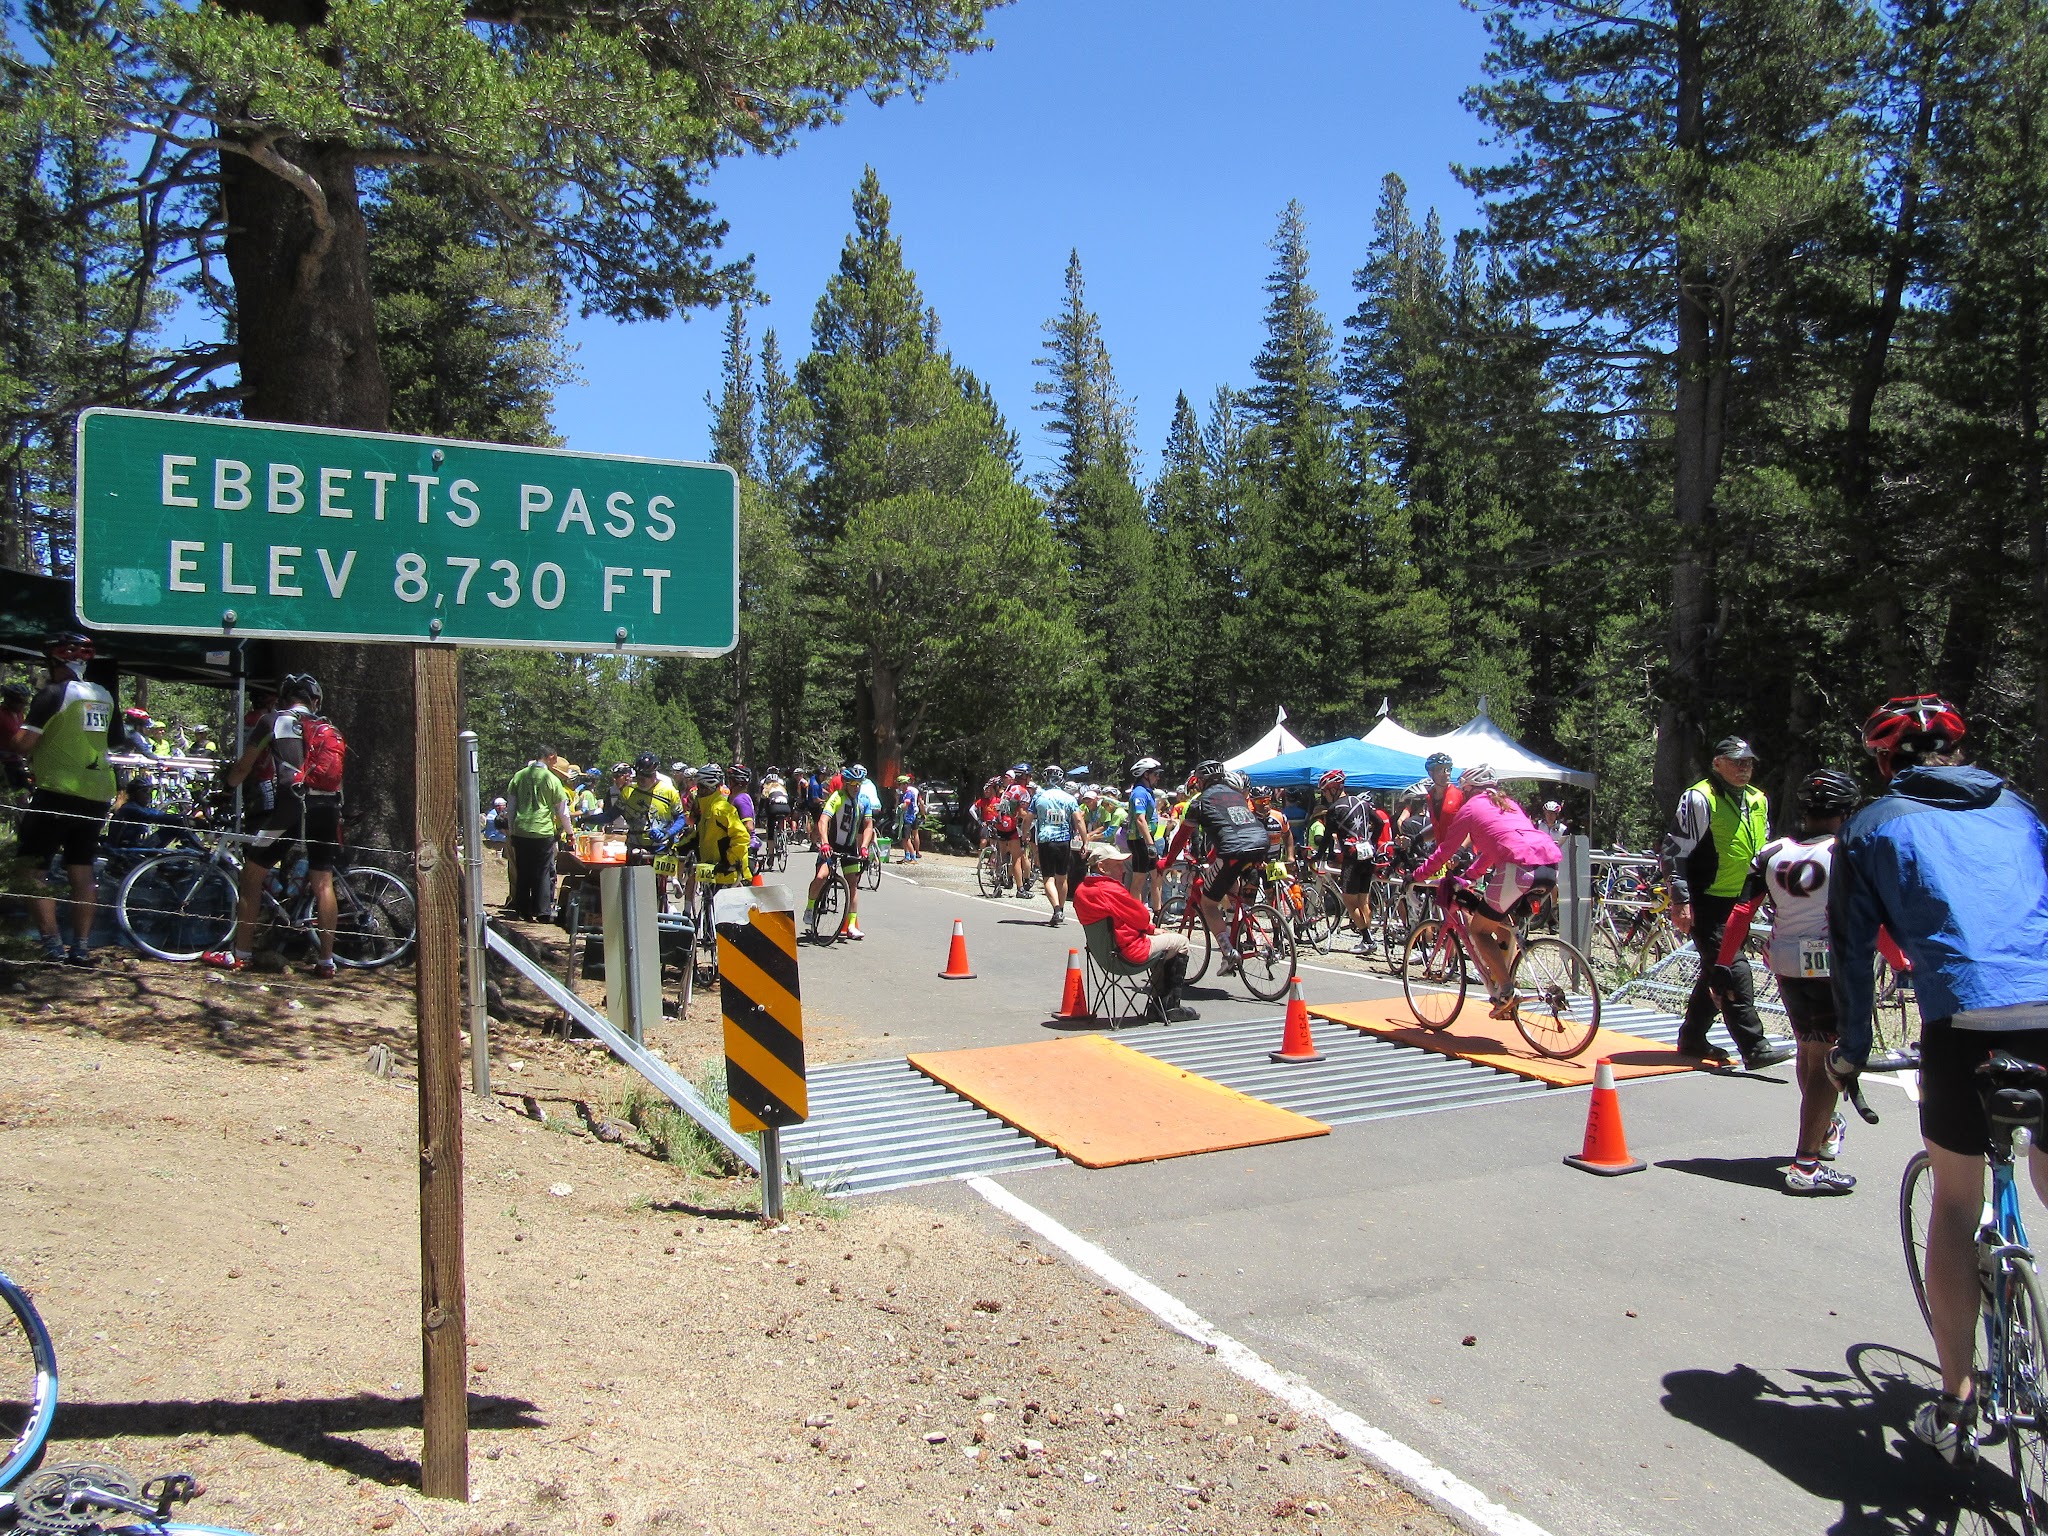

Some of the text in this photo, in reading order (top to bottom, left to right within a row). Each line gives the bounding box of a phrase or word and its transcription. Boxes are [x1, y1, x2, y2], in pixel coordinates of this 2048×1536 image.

[161, 454, 677, 542] EBBETTS PASS
[169, 540, 671, 614] ELEV 8,730 FT
[654, 860, 676, 873] 3093
[1803, 951, 1830, 970] 30
